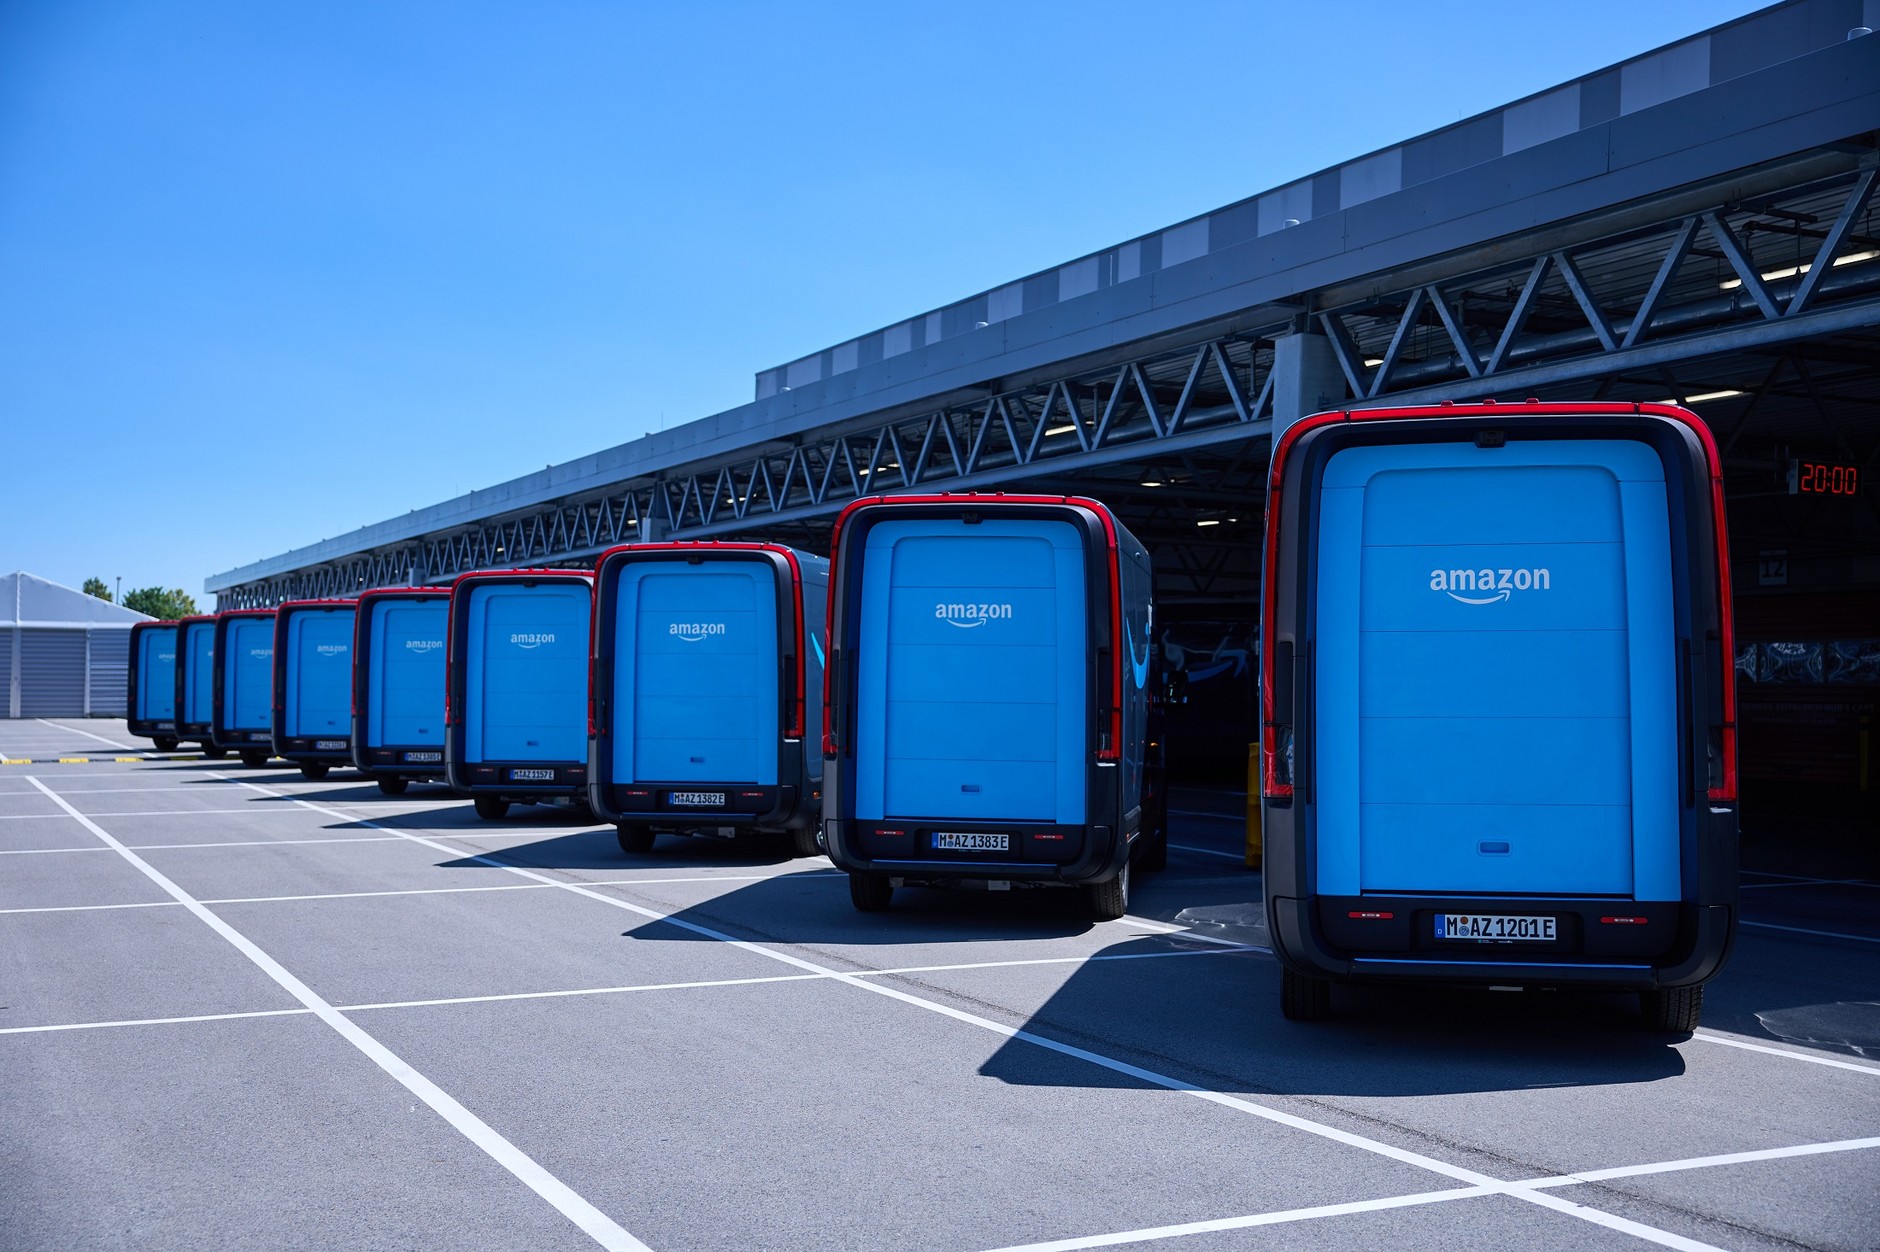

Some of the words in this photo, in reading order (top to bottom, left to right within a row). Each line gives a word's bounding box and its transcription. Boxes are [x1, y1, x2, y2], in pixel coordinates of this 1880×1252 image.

[1801, 464, 1857, 495] 20:00
[1762, 559, 1785, 578] 12
[1429, 568, 1550, 591] amazon
[934, 603, 1012, 620] amazon
[510, 633, 555, 643] amazon
[669, 623, 726, 636] amazon
[405, 640, 443, 649] amazon
[1446, 917, 1458, 936] M
